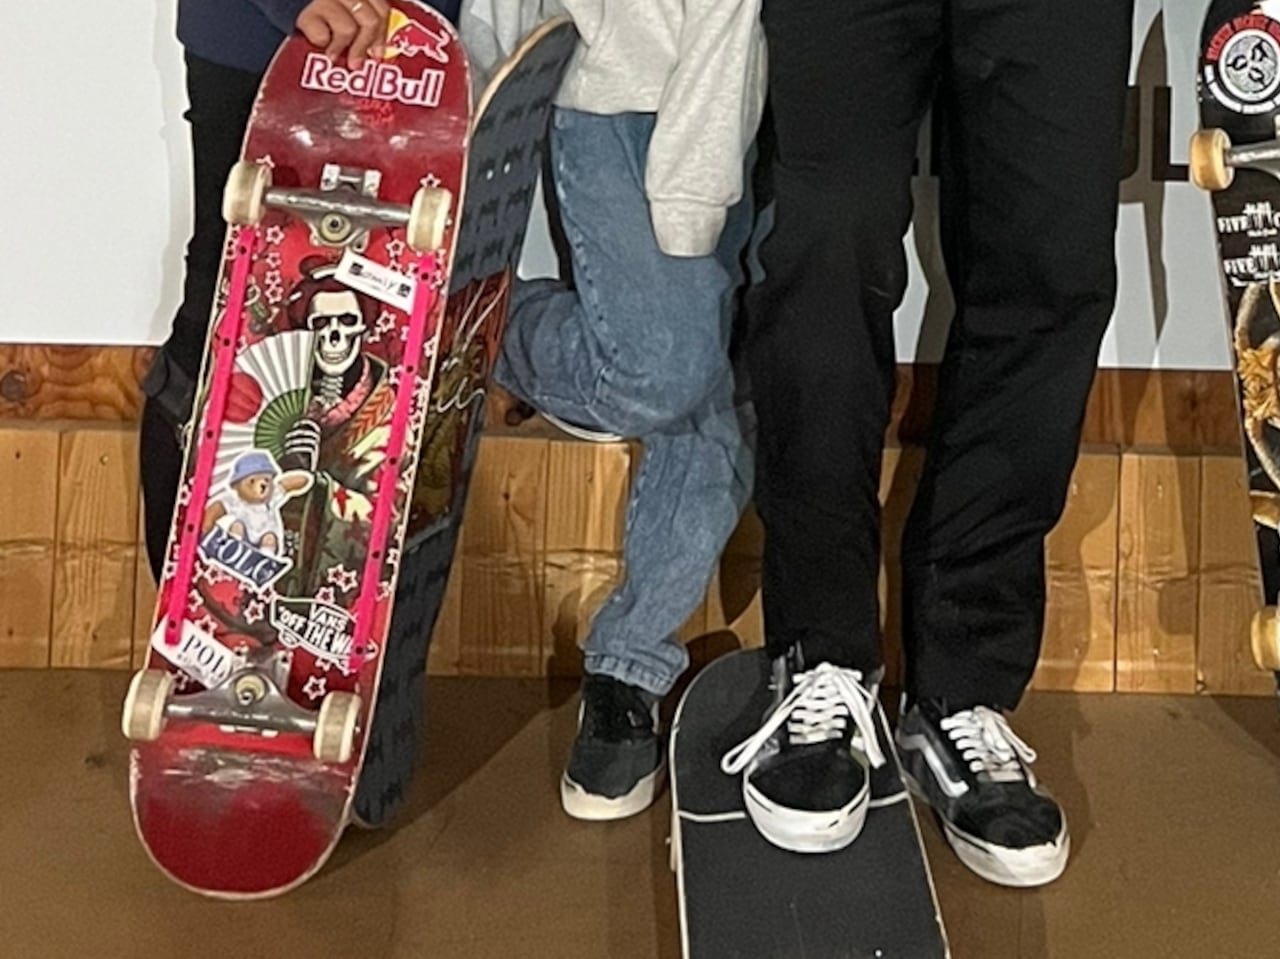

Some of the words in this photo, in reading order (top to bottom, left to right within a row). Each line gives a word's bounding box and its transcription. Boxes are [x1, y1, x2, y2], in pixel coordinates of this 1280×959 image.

[301, 53, 376, 98] Red
[373, 63, 445, 108] Bull
[310, 602, 348, 632] VANS
